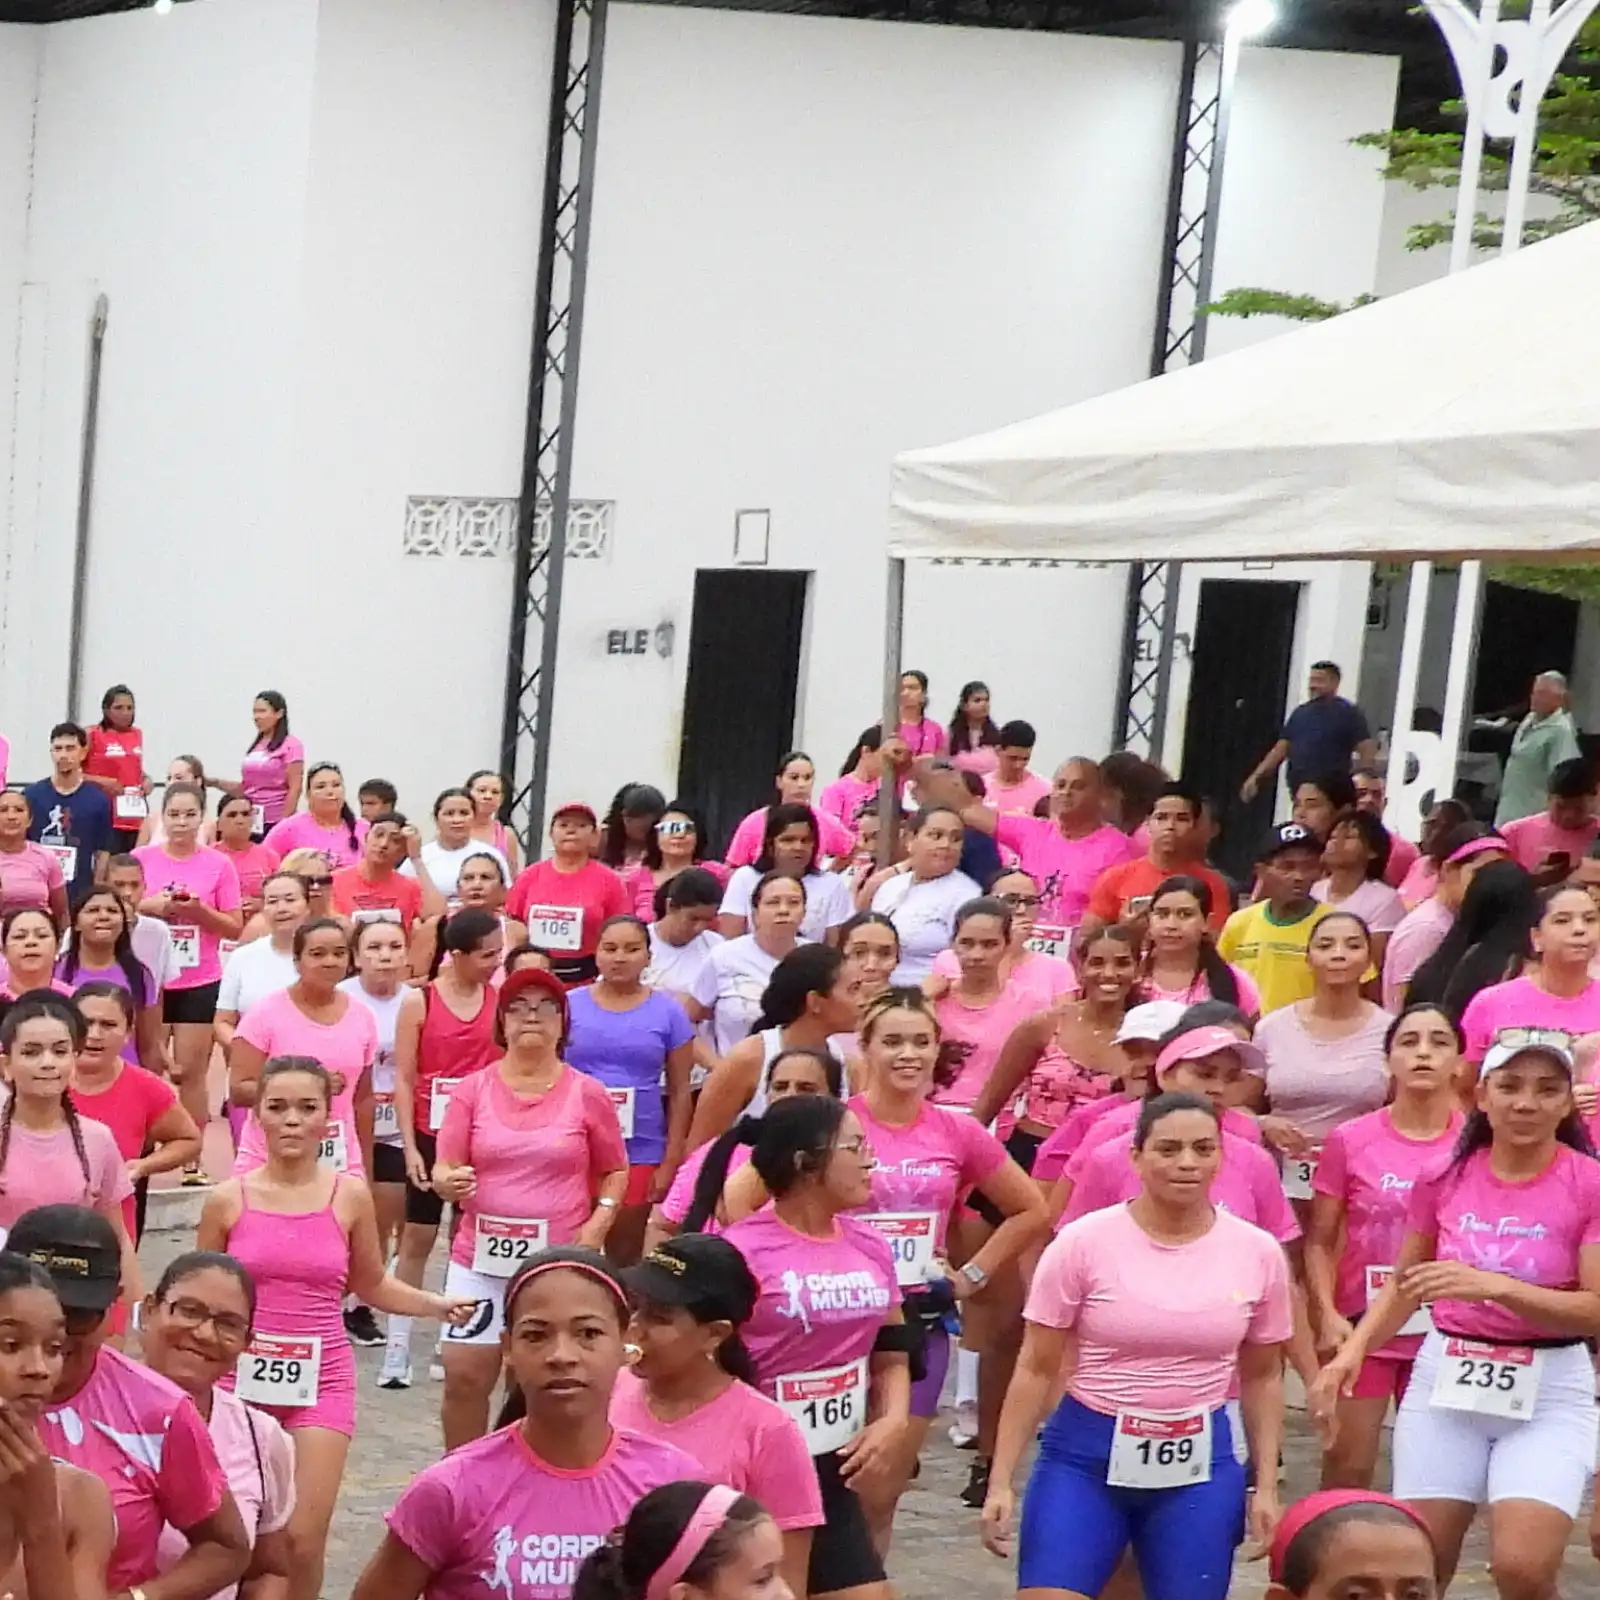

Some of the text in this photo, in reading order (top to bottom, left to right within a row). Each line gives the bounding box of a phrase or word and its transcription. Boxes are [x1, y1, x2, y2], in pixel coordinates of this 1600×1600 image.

[607, 630, 649, 655] ELE
[541, 921, 569, 937] 106
[487, 1236, 532, 1260] 292
[252, 1358, 303, 1384] 259
[1455, 1361, 1517, 1391] 235
[802, 1393, 853, 1429] 166
[1136, 1437, 1194, 1466] 169
